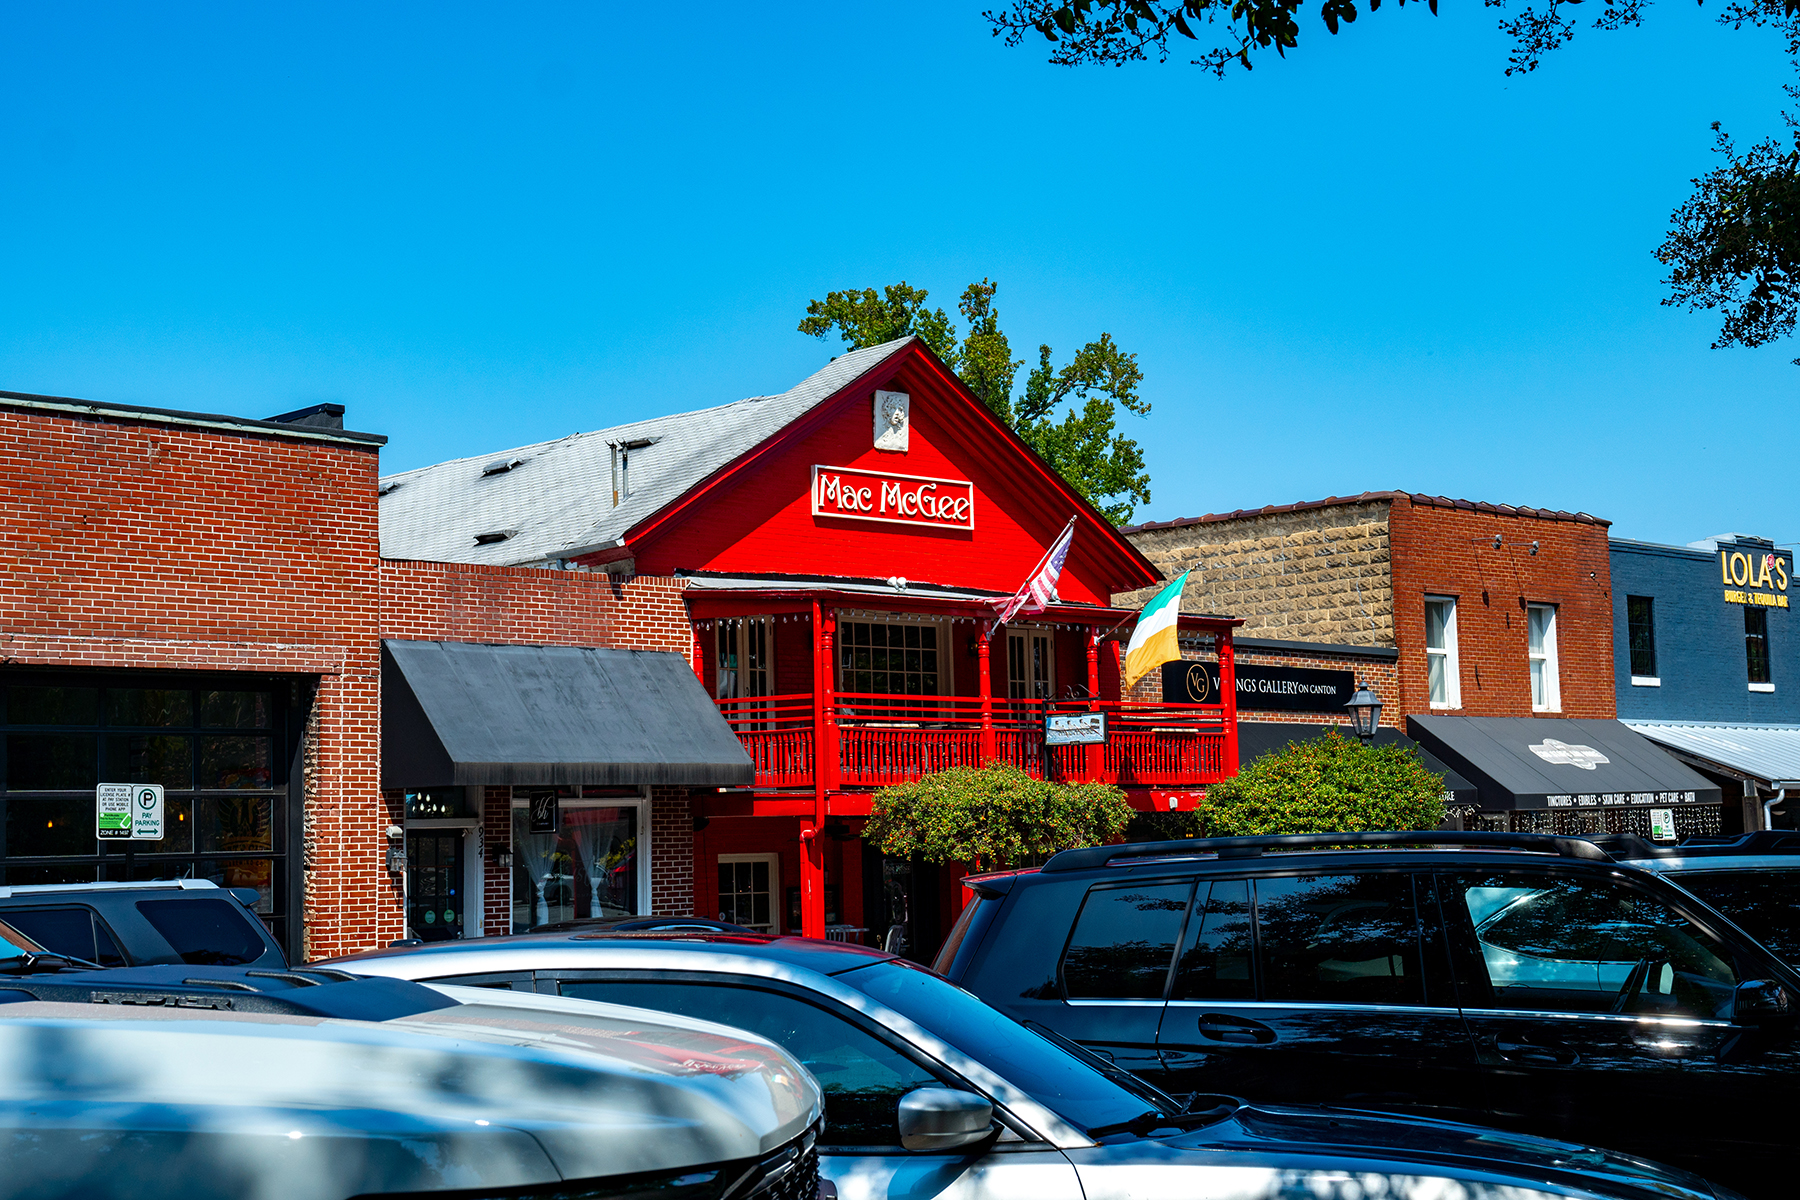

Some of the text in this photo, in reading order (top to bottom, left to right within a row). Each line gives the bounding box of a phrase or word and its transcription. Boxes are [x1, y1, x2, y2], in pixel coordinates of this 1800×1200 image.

[818, 474, 970, 521] Mac McGee
[1724, 590, 1788, 607] BURGER & TEQUILA BAR
[1190, 672, 1205, 693] VG
[1213, 677, 1337, 695] VNGS GALLERY ON CANTON
[143, 792, 153, 806] P
[1547, 792, 1695, 807] TINCTURES EDIBLES SKIN CARE EDUCATION PET CARE BATH
